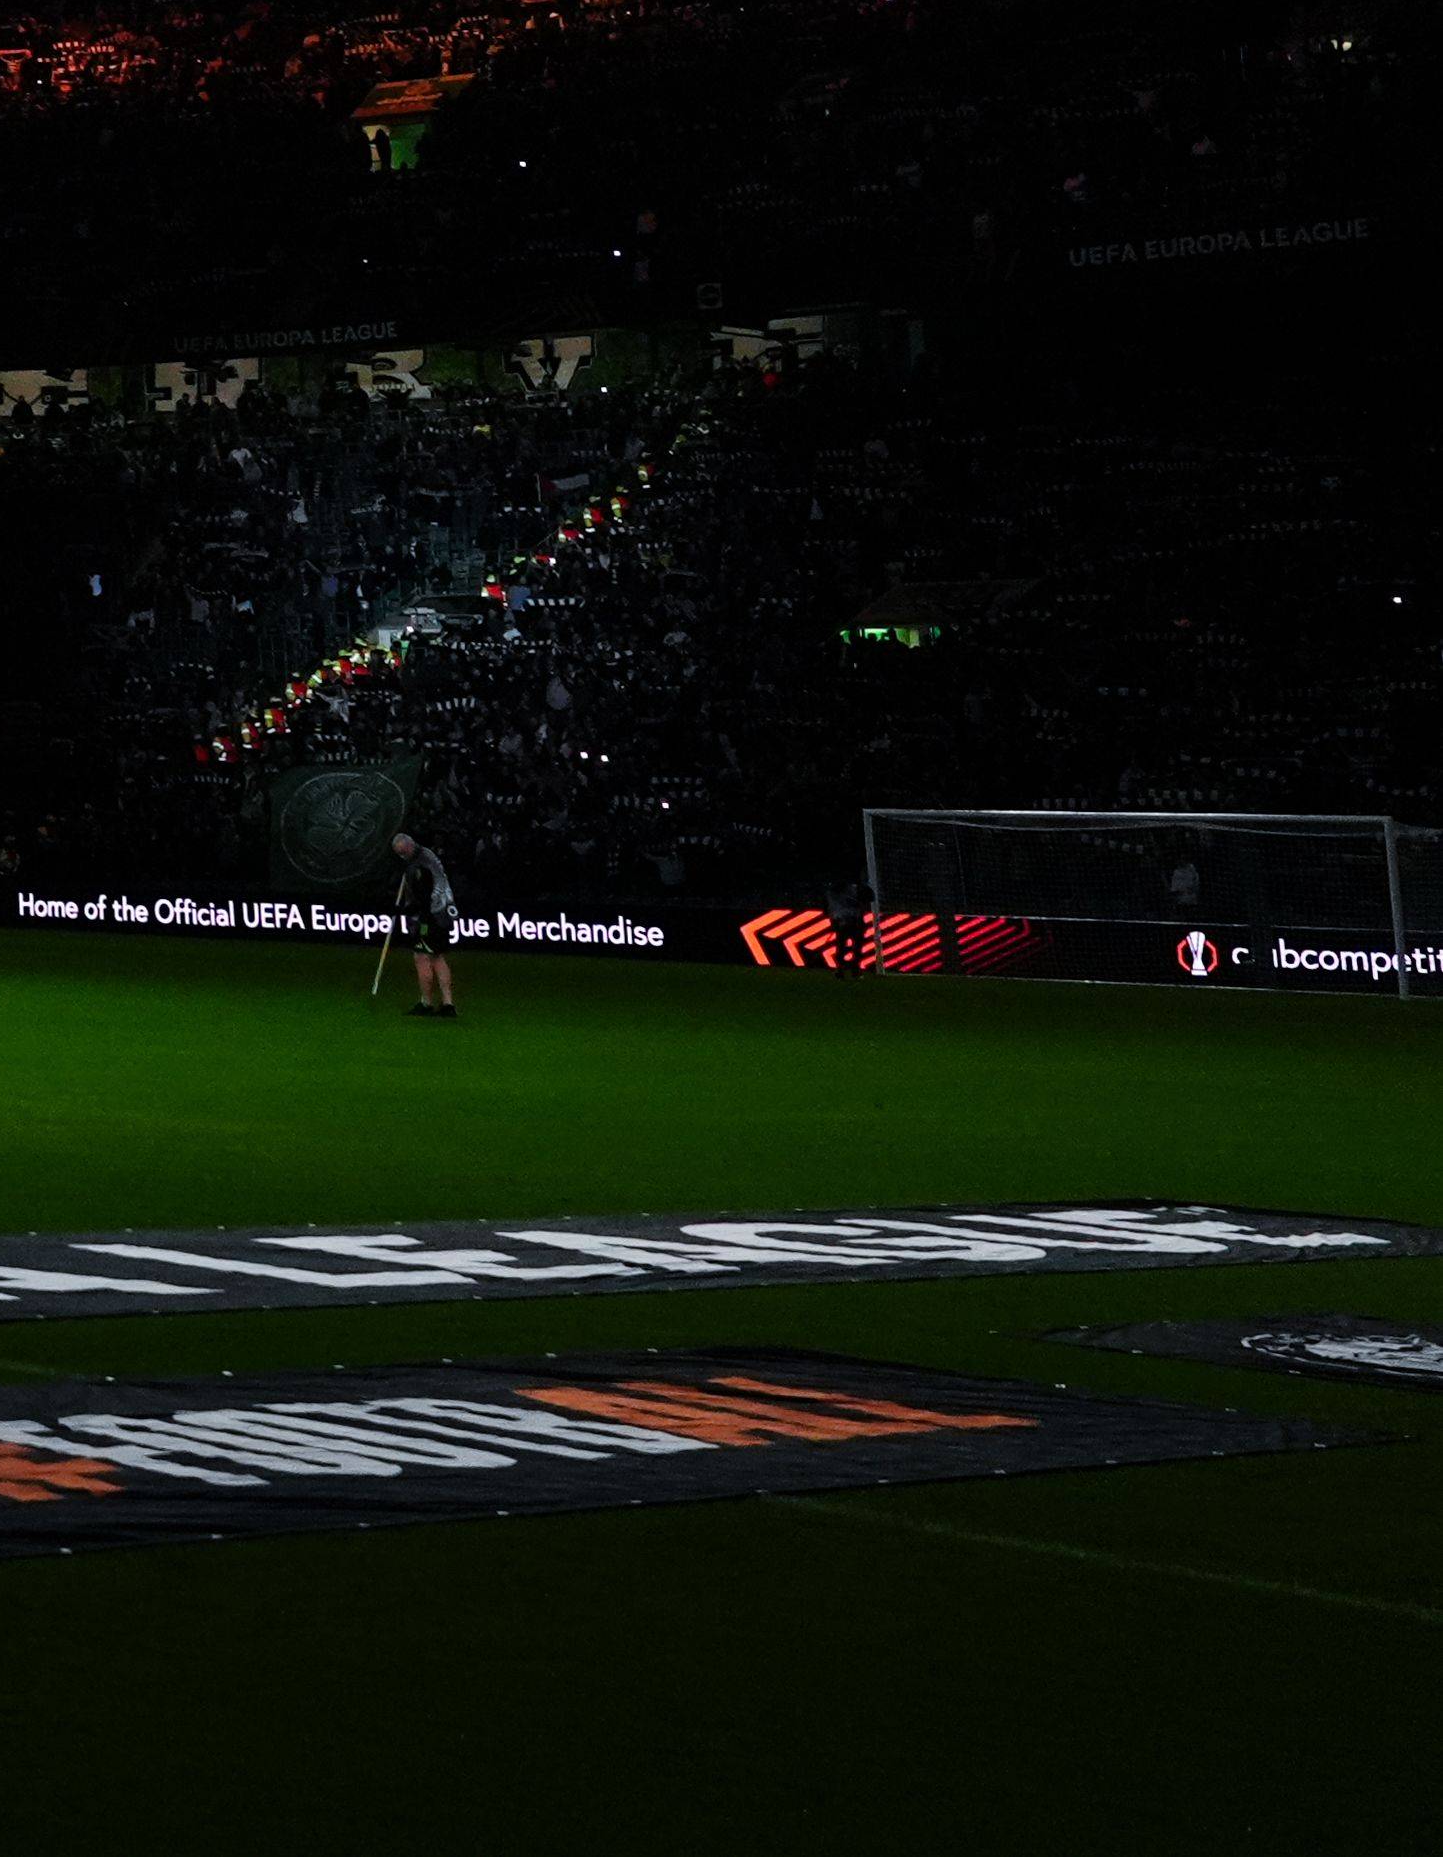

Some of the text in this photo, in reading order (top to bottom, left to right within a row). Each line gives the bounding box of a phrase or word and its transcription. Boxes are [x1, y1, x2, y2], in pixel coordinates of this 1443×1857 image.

[1068, 217, 1371, 268] UEFA EUROPA LEAGUE
[19, 893, 79, 919] Home
[84, 895, 107, 920] of
[112, 896, 149, 923] the
[155, 898, 236, 927] Official
[243, 903, 306, 930] UEFA
[311, 905, 393, 940] Europa
[498, 912, 665, 947] Merchandise
[67, 1206, 1391, 1288] LEAGUE
